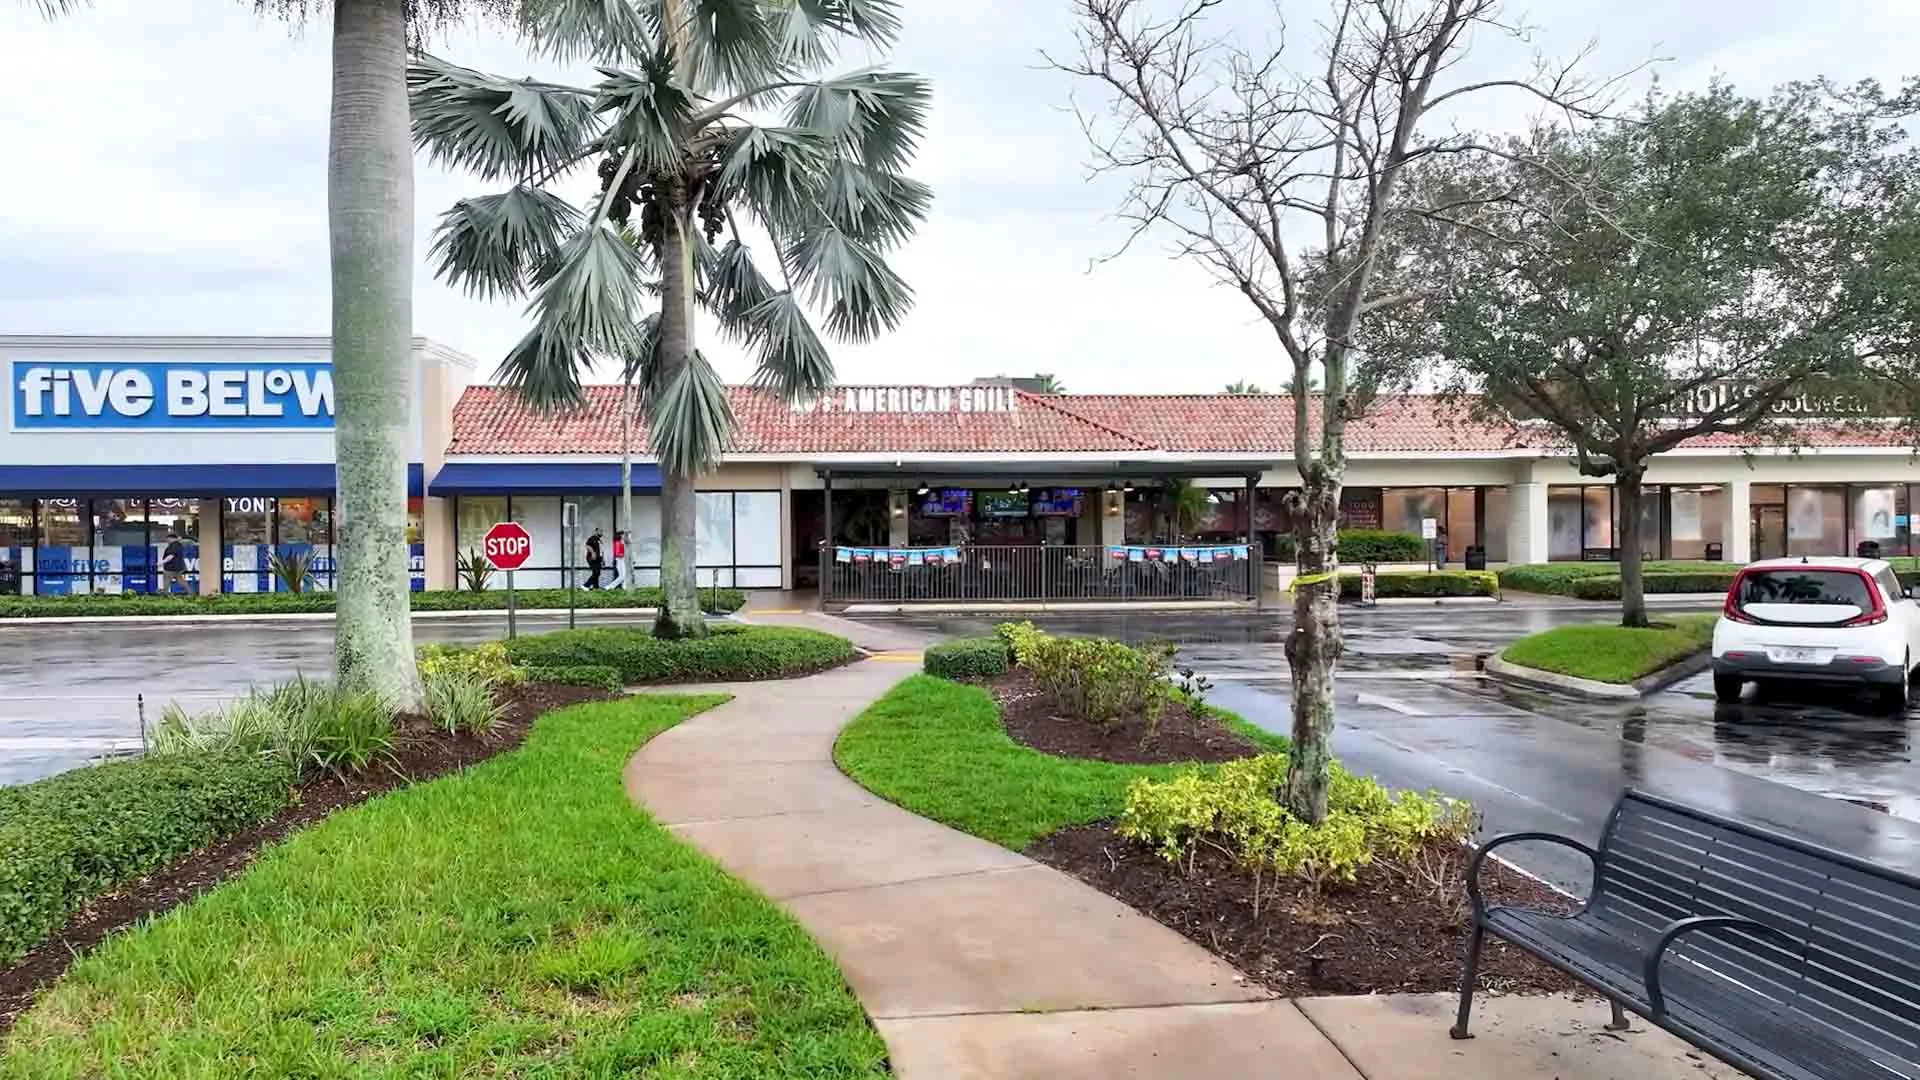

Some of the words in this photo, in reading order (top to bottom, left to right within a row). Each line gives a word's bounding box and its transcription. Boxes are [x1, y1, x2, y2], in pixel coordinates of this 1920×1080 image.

[19, 368, 154, 417] five
[846, 388, 951, 412] AMERICAN
[959, 388, 1015, 412] GRILL
[487, 537, 528, 556] STOP
